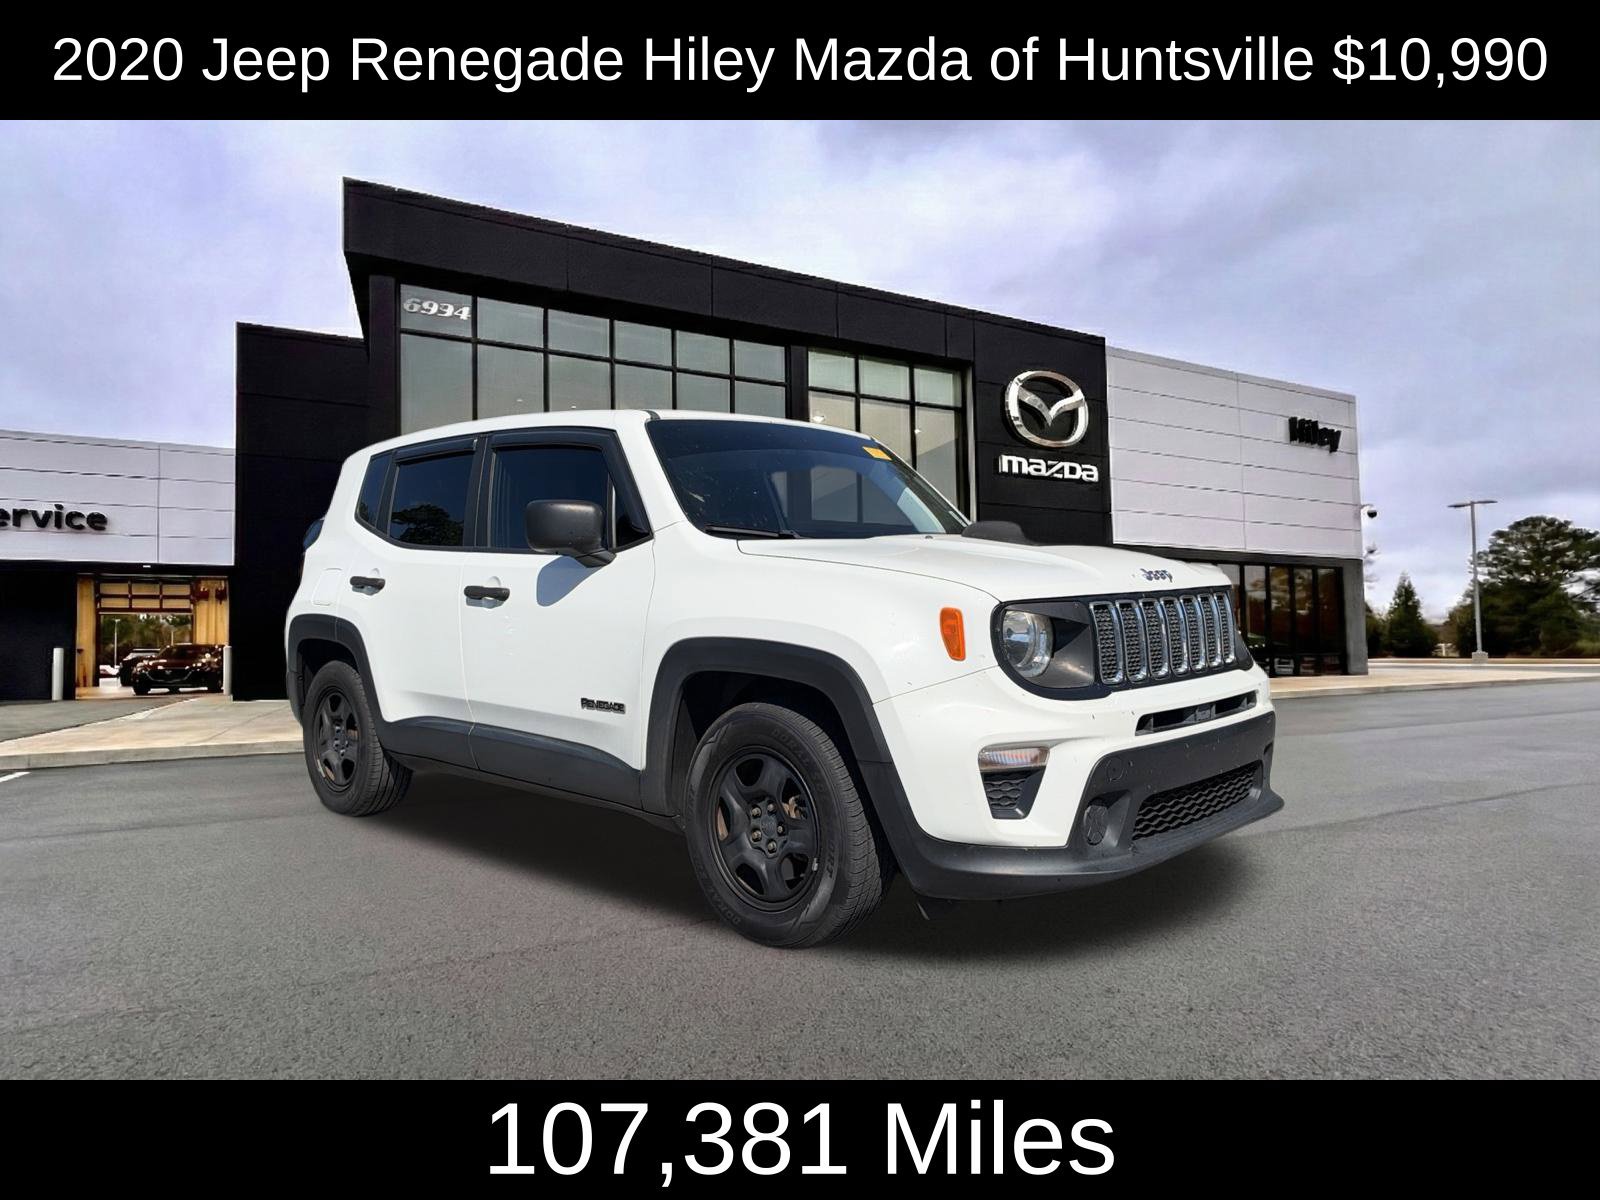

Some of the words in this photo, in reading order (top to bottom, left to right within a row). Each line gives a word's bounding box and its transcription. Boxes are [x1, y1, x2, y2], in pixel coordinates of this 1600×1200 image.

[1288, 416, 1342, 454] Hiley
[1140, 568, 1173, 583] Jeep
[580, 697, 626, 715] RENEGADE
